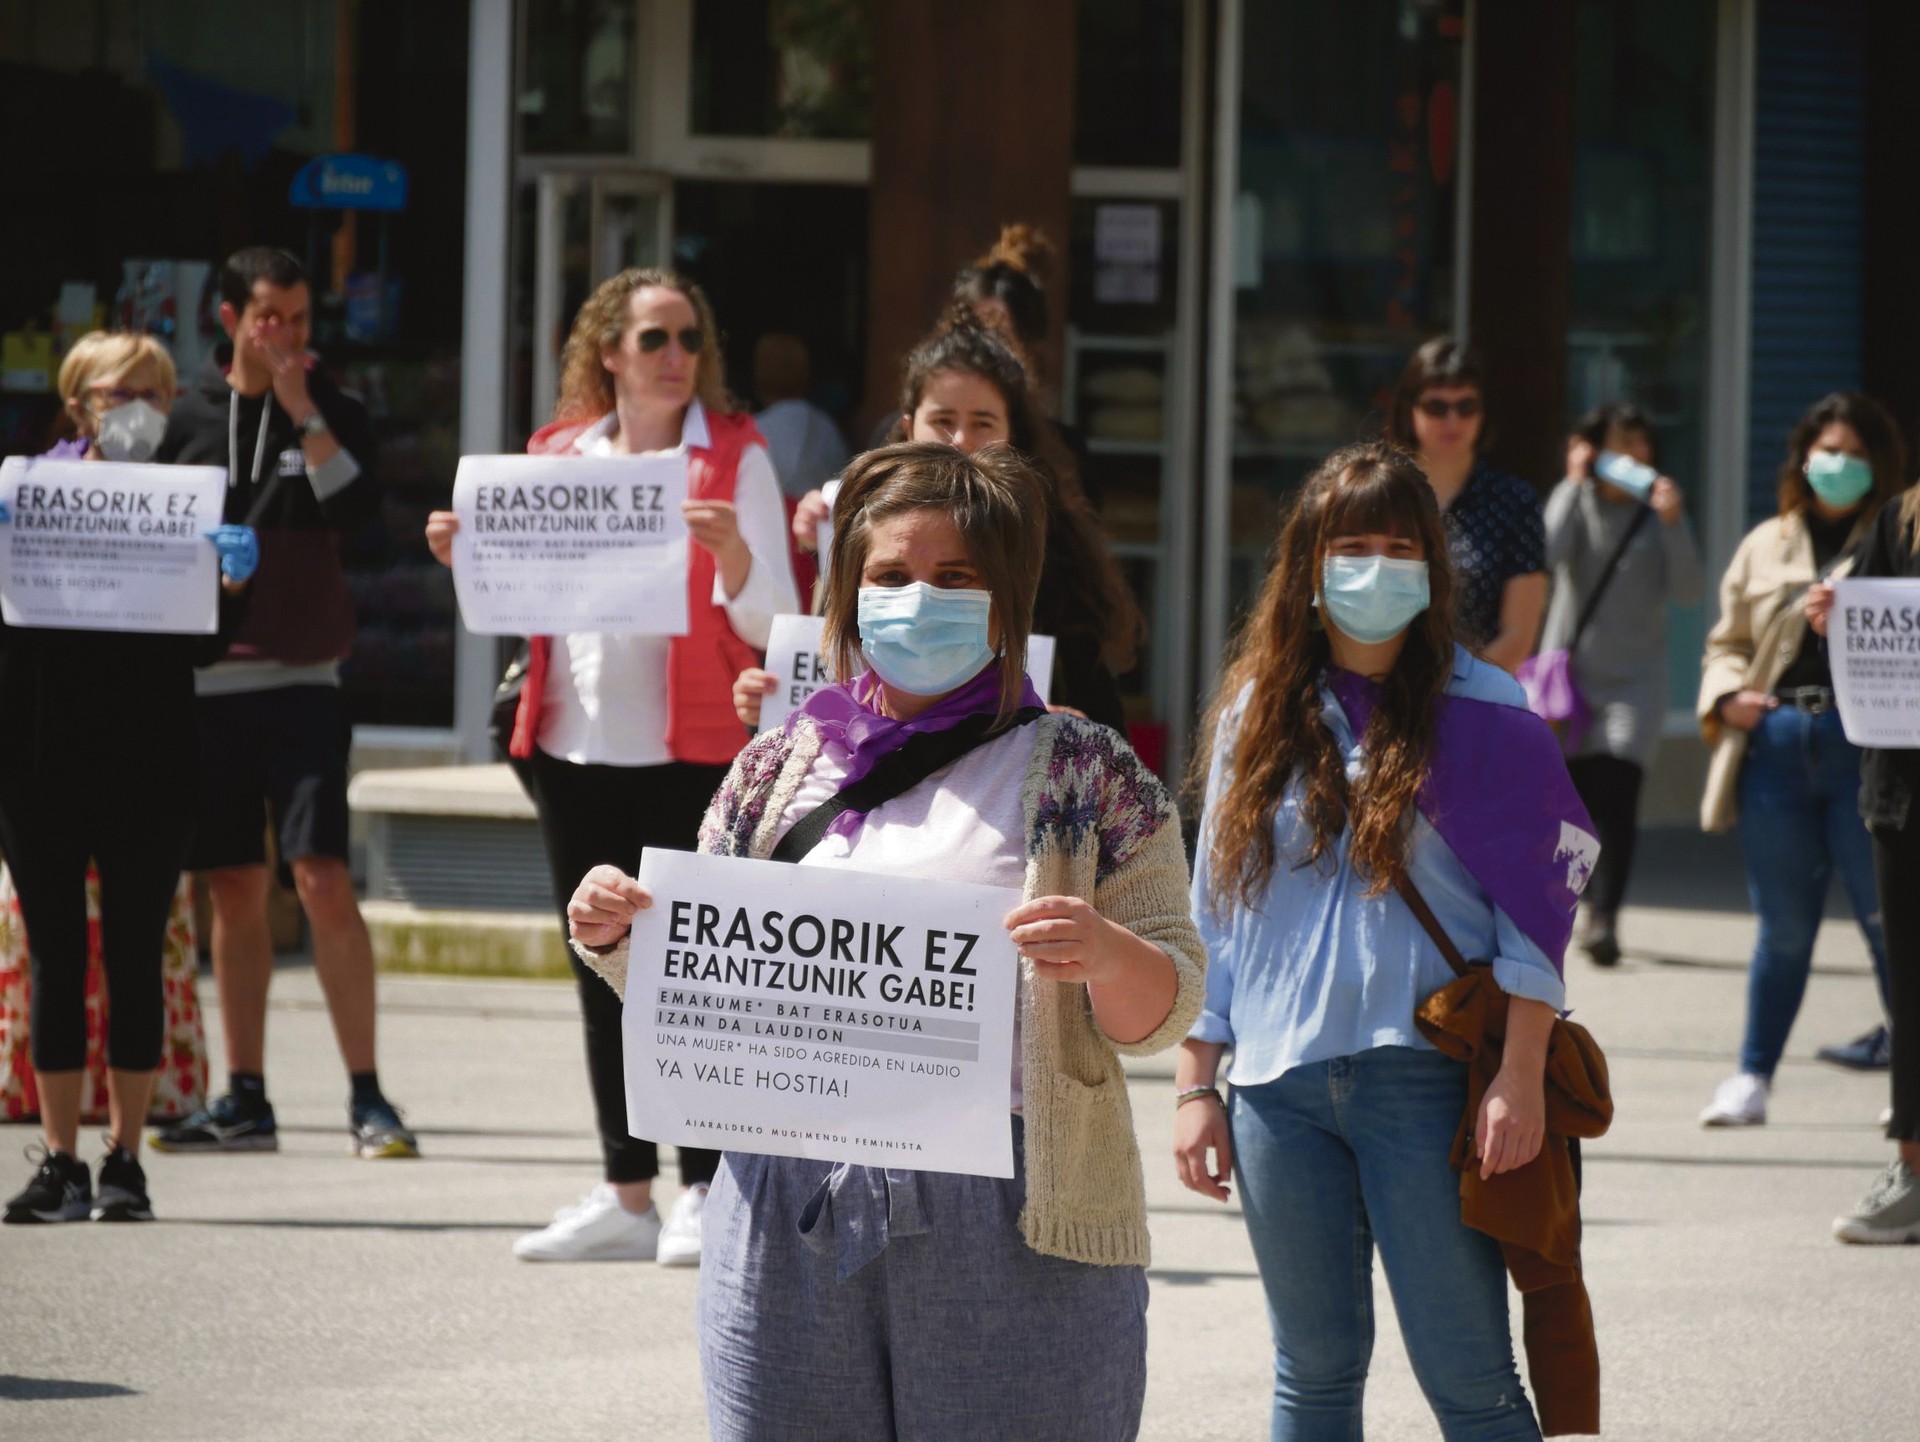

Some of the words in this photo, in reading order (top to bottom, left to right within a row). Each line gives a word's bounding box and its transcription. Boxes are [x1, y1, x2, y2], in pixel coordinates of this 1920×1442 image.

[16, 484, 153, 515] ERASORIK
[166, 493, 197, 518] EZ
[475, 485, 619, 511] ERASORIK
[632, 486, 664, 511] EZ
[14, 512, 130, 535] ERANTZUNIK
[139, 518, 195, 538] GABE!
[475, 514, 598, 533] ERANTZUNIK
[607, 515, 664, 532] GABE!
[1846, 607, 1920, 632] ERAS
[1847, 636, 1920, 653] ERANTZ
[669, 900, 905, 967] ERASORIK
[925, 929, 980, 976] EZ
[664, 949, 867, 999] ERANTZUNIK
[879, 973, 975, 1012] GABE!
[658, 1012, 705, 1028] IZAN
[718, 1017, 742, 1032] DA
[755, 1022, 843, 1042] LAUDION
[777, 1004, 810, 1019] BAT
[823, 1009, 923, 1032] ERASOTUA
[656, 1033, 687, 1047] UNA
[749, 1043, 767, 1056] HA
[774, 1046, 807, 1060] SIDO
[812, 1050, 881, 1069] AGREDIDA
[887, 1059, 905, 1071] EN
[910, 1061, 960, 1078] LAUDIO
[656, 1059, 683, 1080] YA
[694, 1063, 744, 1086] VALE
[756, 1070, 848, 1098] HOSTIA!
[685, 1119, 763, 1134] AIARALDEKO
[772, 1129, 847, 1143] MUGIMENDU
[855, 1138, 922, 1151] FEMINISTA
